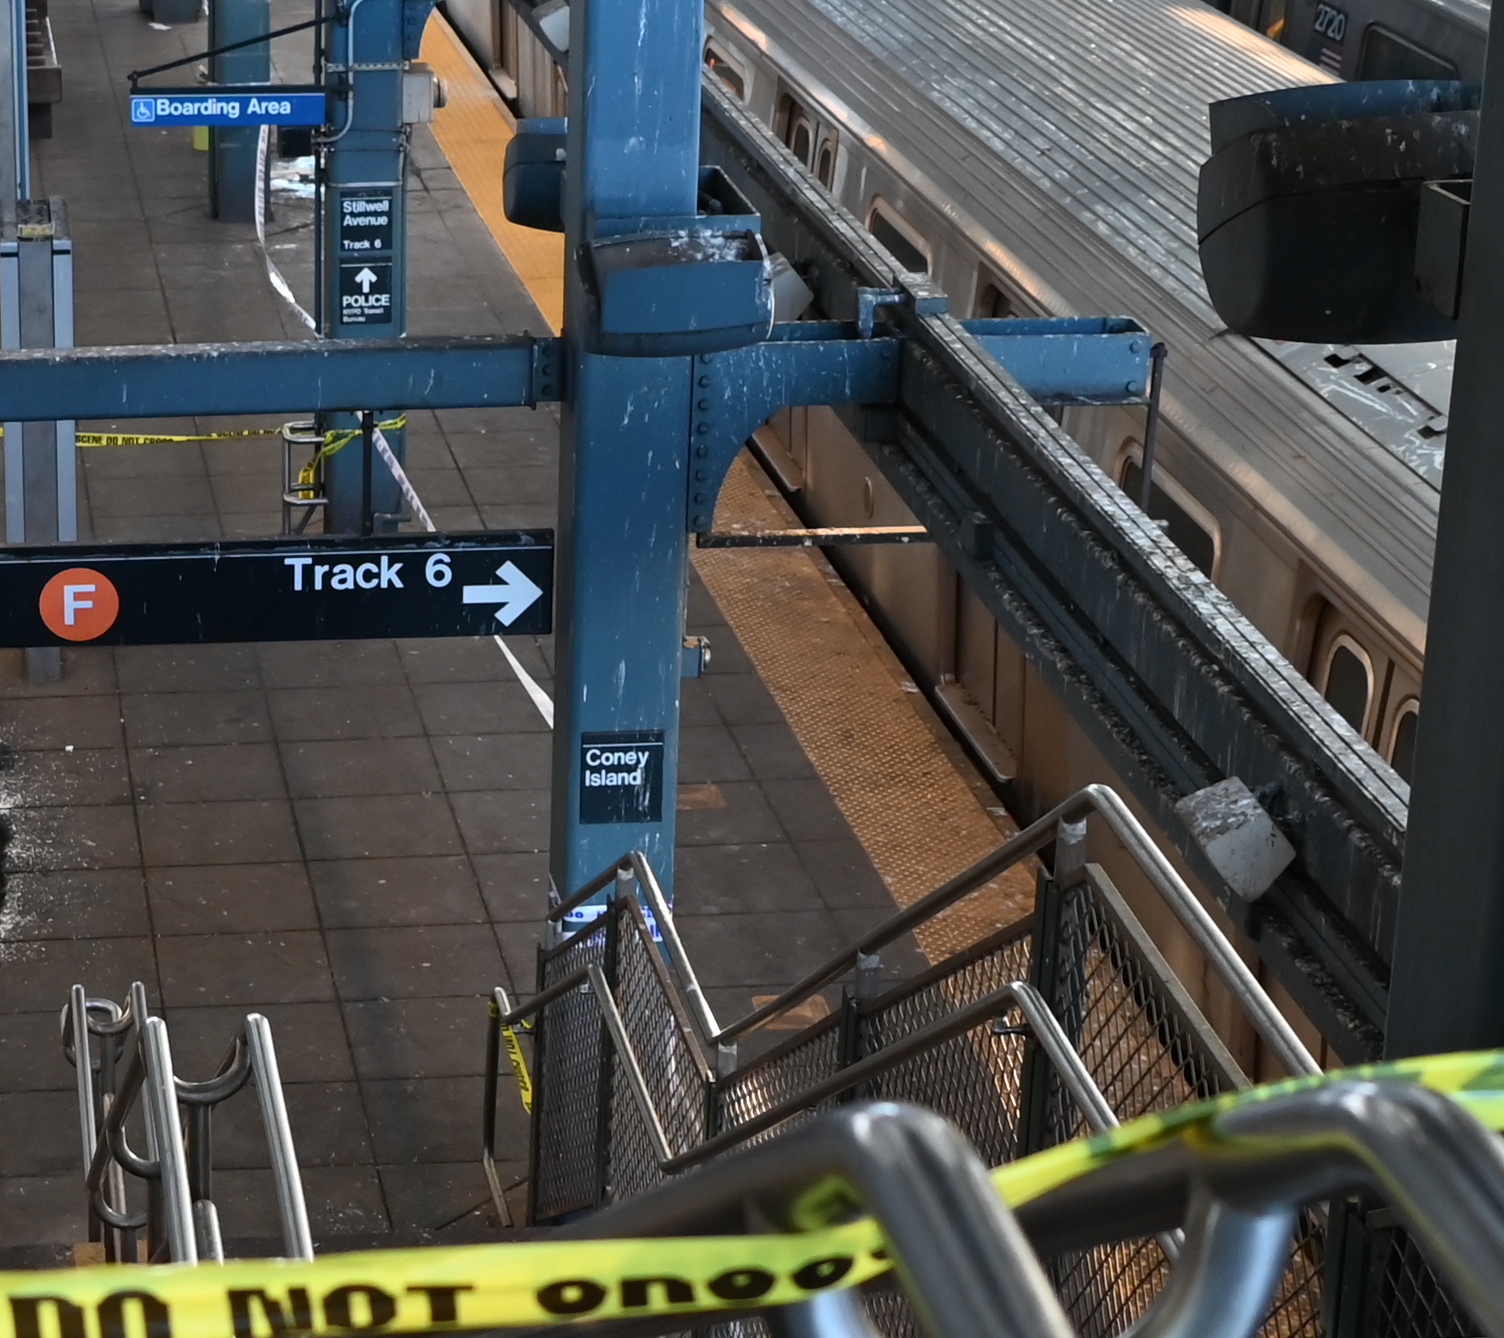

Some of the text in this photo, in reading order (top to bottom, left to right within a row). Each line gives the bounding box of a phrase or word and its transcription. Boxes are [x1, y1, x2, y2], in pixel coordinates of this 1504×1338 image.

[1315, 3, 1345, 41] 2720
[156, 98, 292, 119] Boarding Area
[343, 199, 389, 213] Stillwell
[343, 214, 388, 227] Avenue
[343, 238, 382, 249] Track 6
[342, 294, 390, 307] POLICE
[283, 554, 453, 592] Track 6
[61, 584, 96, 626] F
[585, 749, 649, 767] Coney
[585, 769, 642, 787] Island
